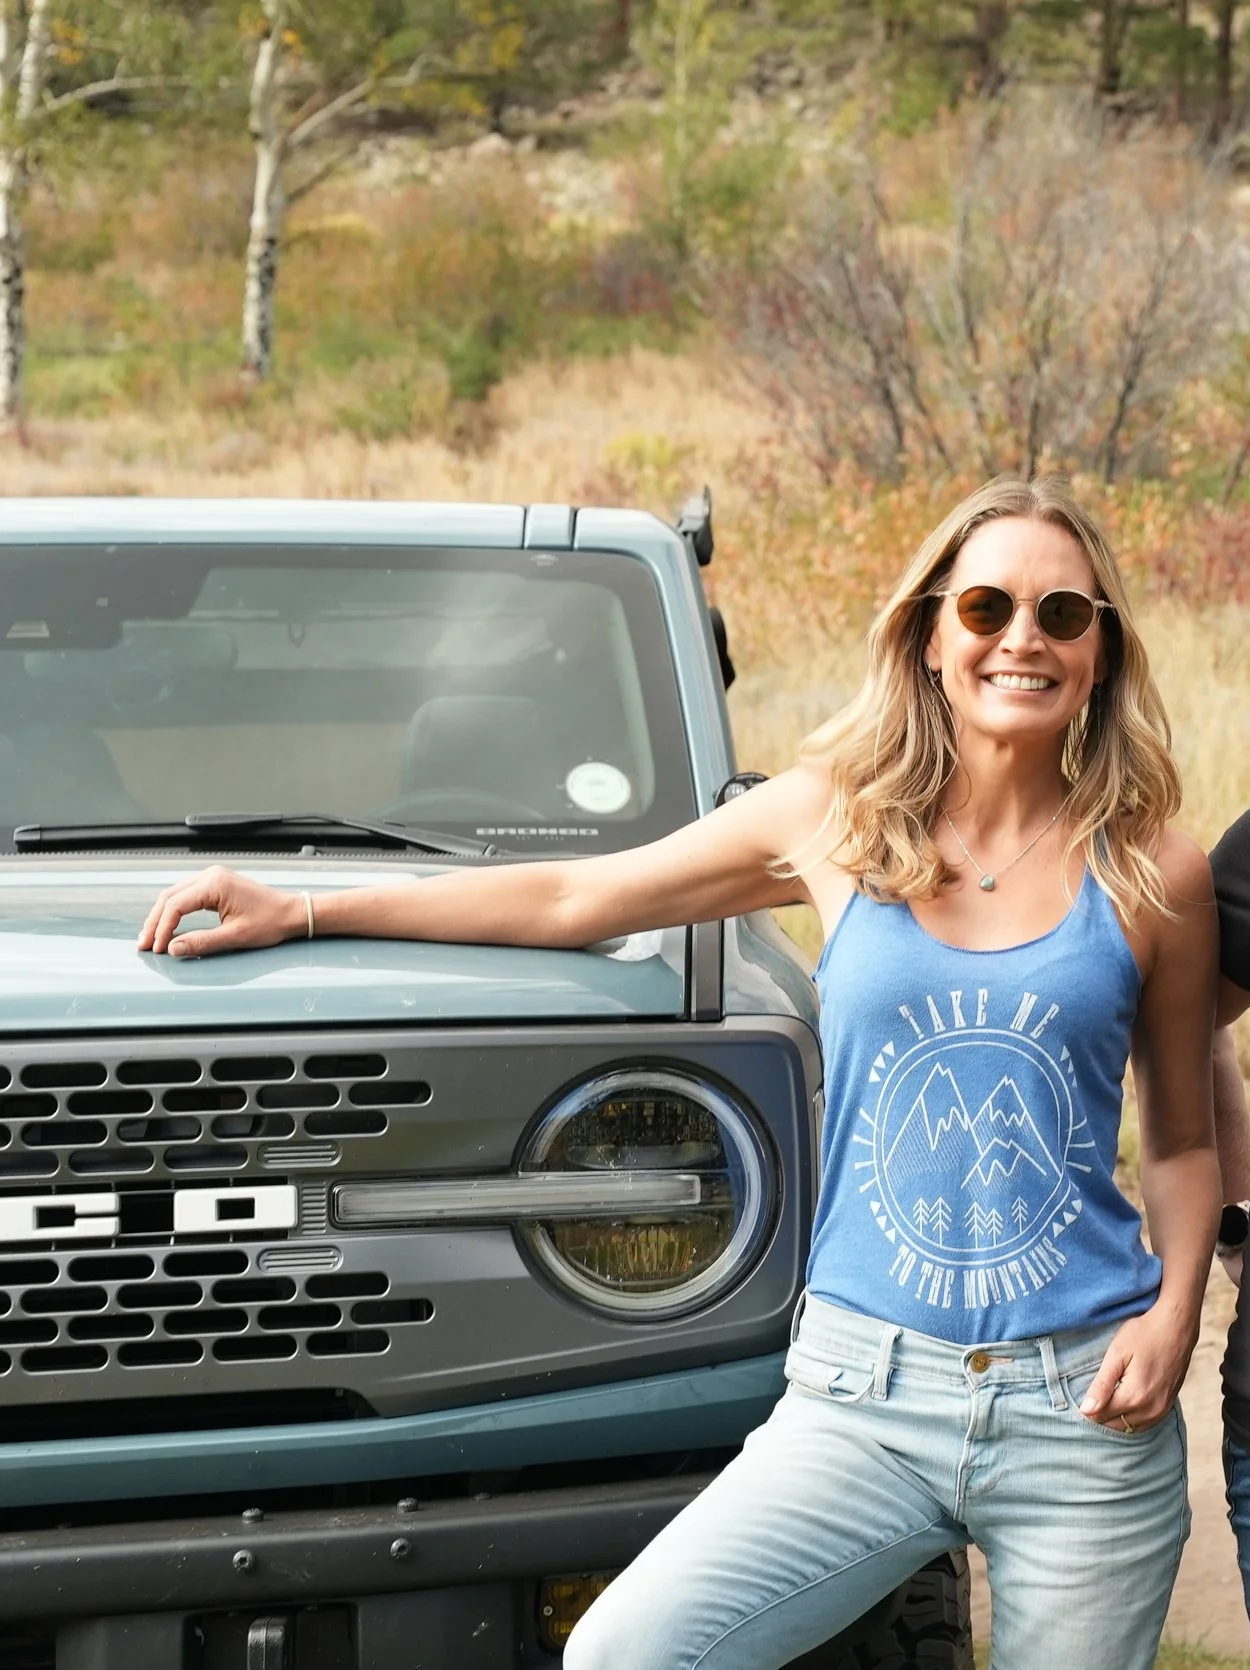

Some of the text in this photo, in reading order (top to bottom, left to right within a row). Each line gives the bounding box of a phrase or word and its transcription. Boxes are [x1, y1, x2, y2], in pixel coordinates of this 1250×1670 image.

[476, 827, 599, 836] BRONCO
[898, 988, 1060, 1041] TAKE ME
[888, 1235, 1068, 1309] TO THE MOUNTAINS
